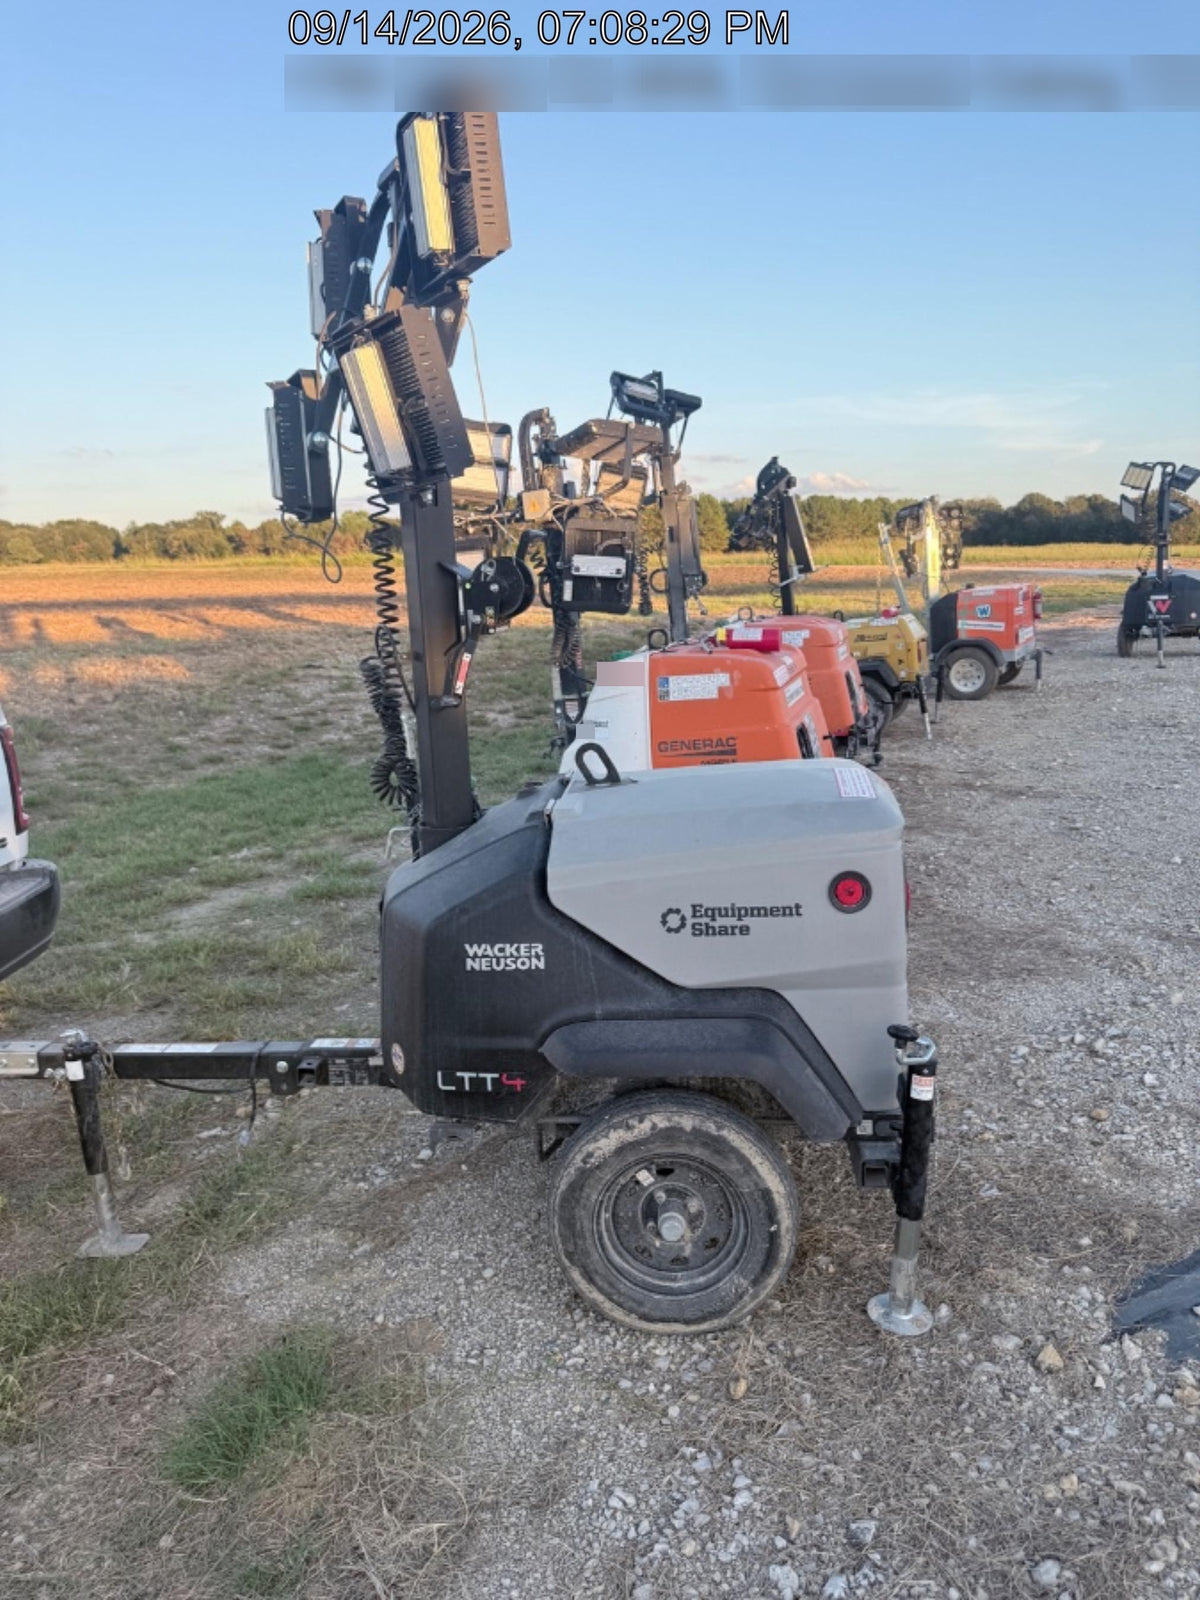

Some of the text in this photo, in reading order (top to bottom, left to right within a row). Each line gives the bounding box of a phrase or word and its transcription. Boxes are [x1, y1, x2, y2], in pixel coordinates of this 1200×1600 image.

[657, 736, 737, 753] GENERAC
[691, 902, 803, 922] Equipment
[691, 922, 751, 937] Share
[464, 943, 545, 958] WACKER
[465, 956, 545, 971] NEUSON
[436, 1070, 526, 1092] LTT4
